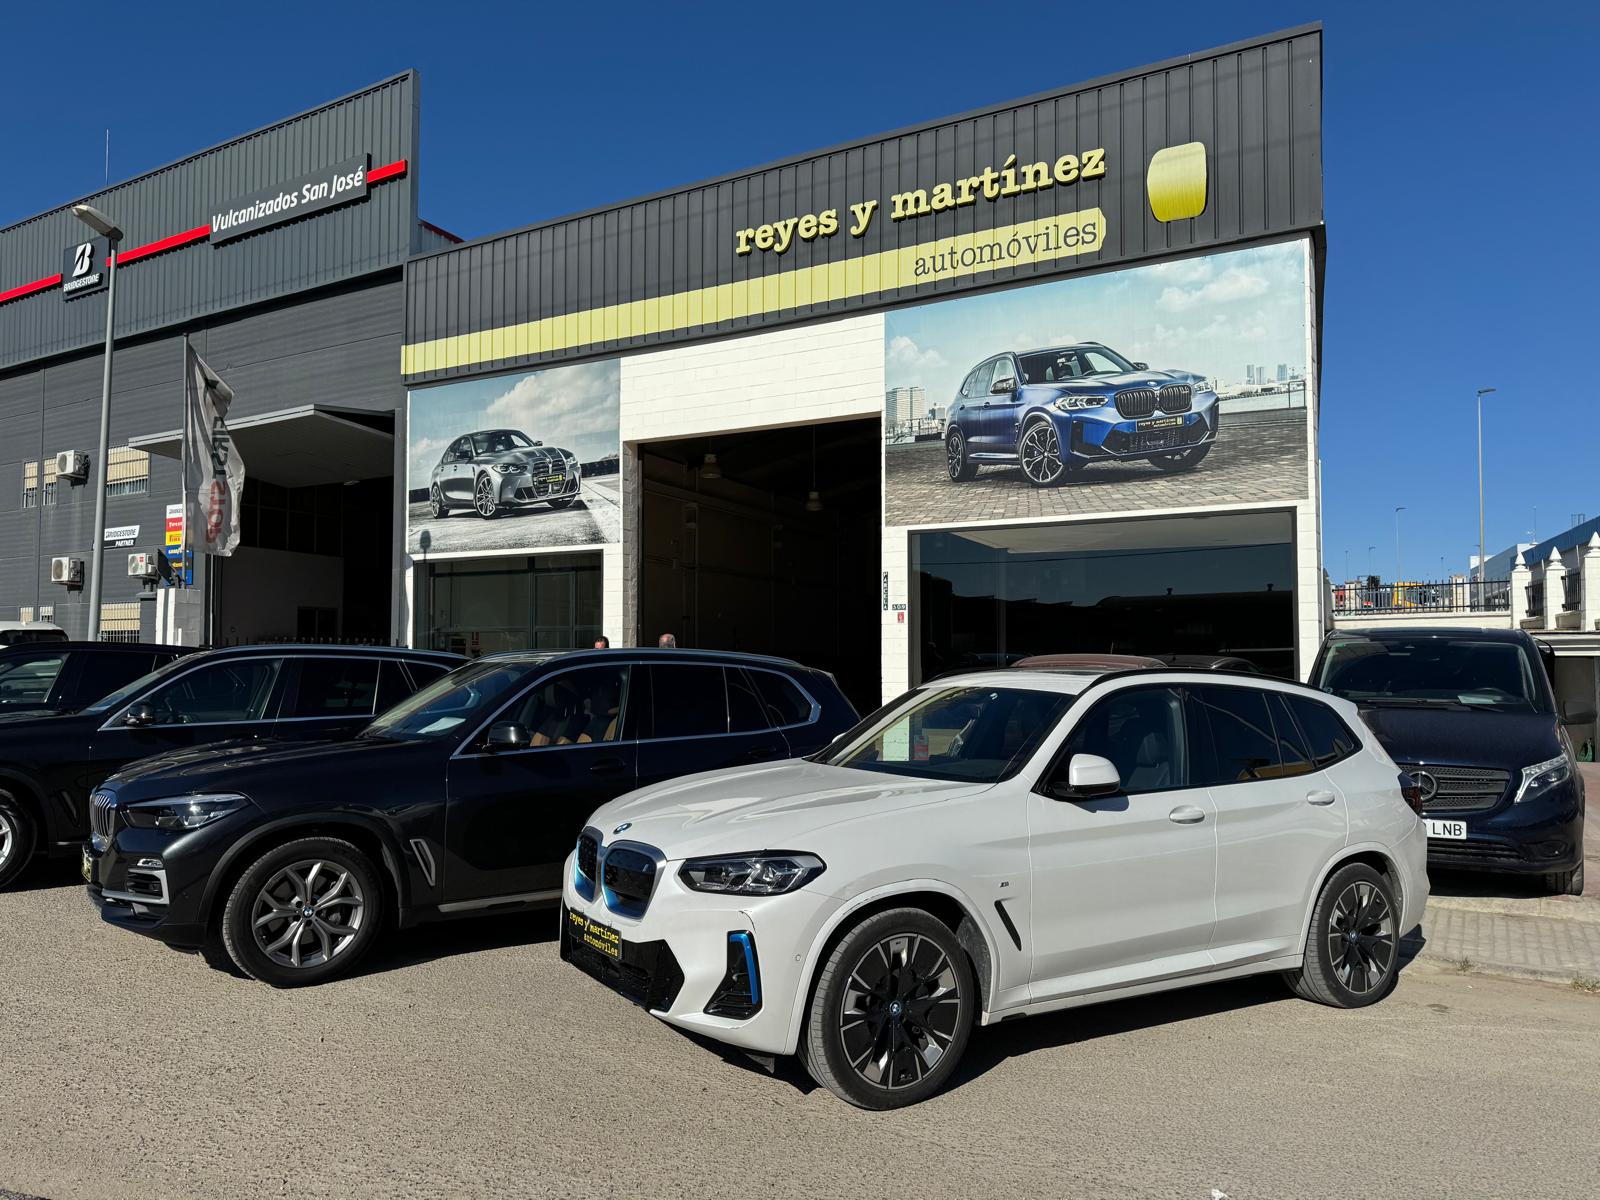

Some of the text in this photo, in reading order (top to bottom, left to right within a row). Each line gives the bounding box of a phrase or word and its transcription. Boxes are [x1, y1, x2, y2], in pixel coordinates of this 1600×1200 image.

[212, 165, 364, 233] Vulcanizados San José
[736, 148, 1105, 254] reyes y martínez
[914, 221, 1098, 277] automóviles
[63, 272, 101, 292] BRIDGESTONE
[1433, 822, 1462, 836] LNB
[570, 912, 583, 926] reyes
[584, 920, 590, 931] y
